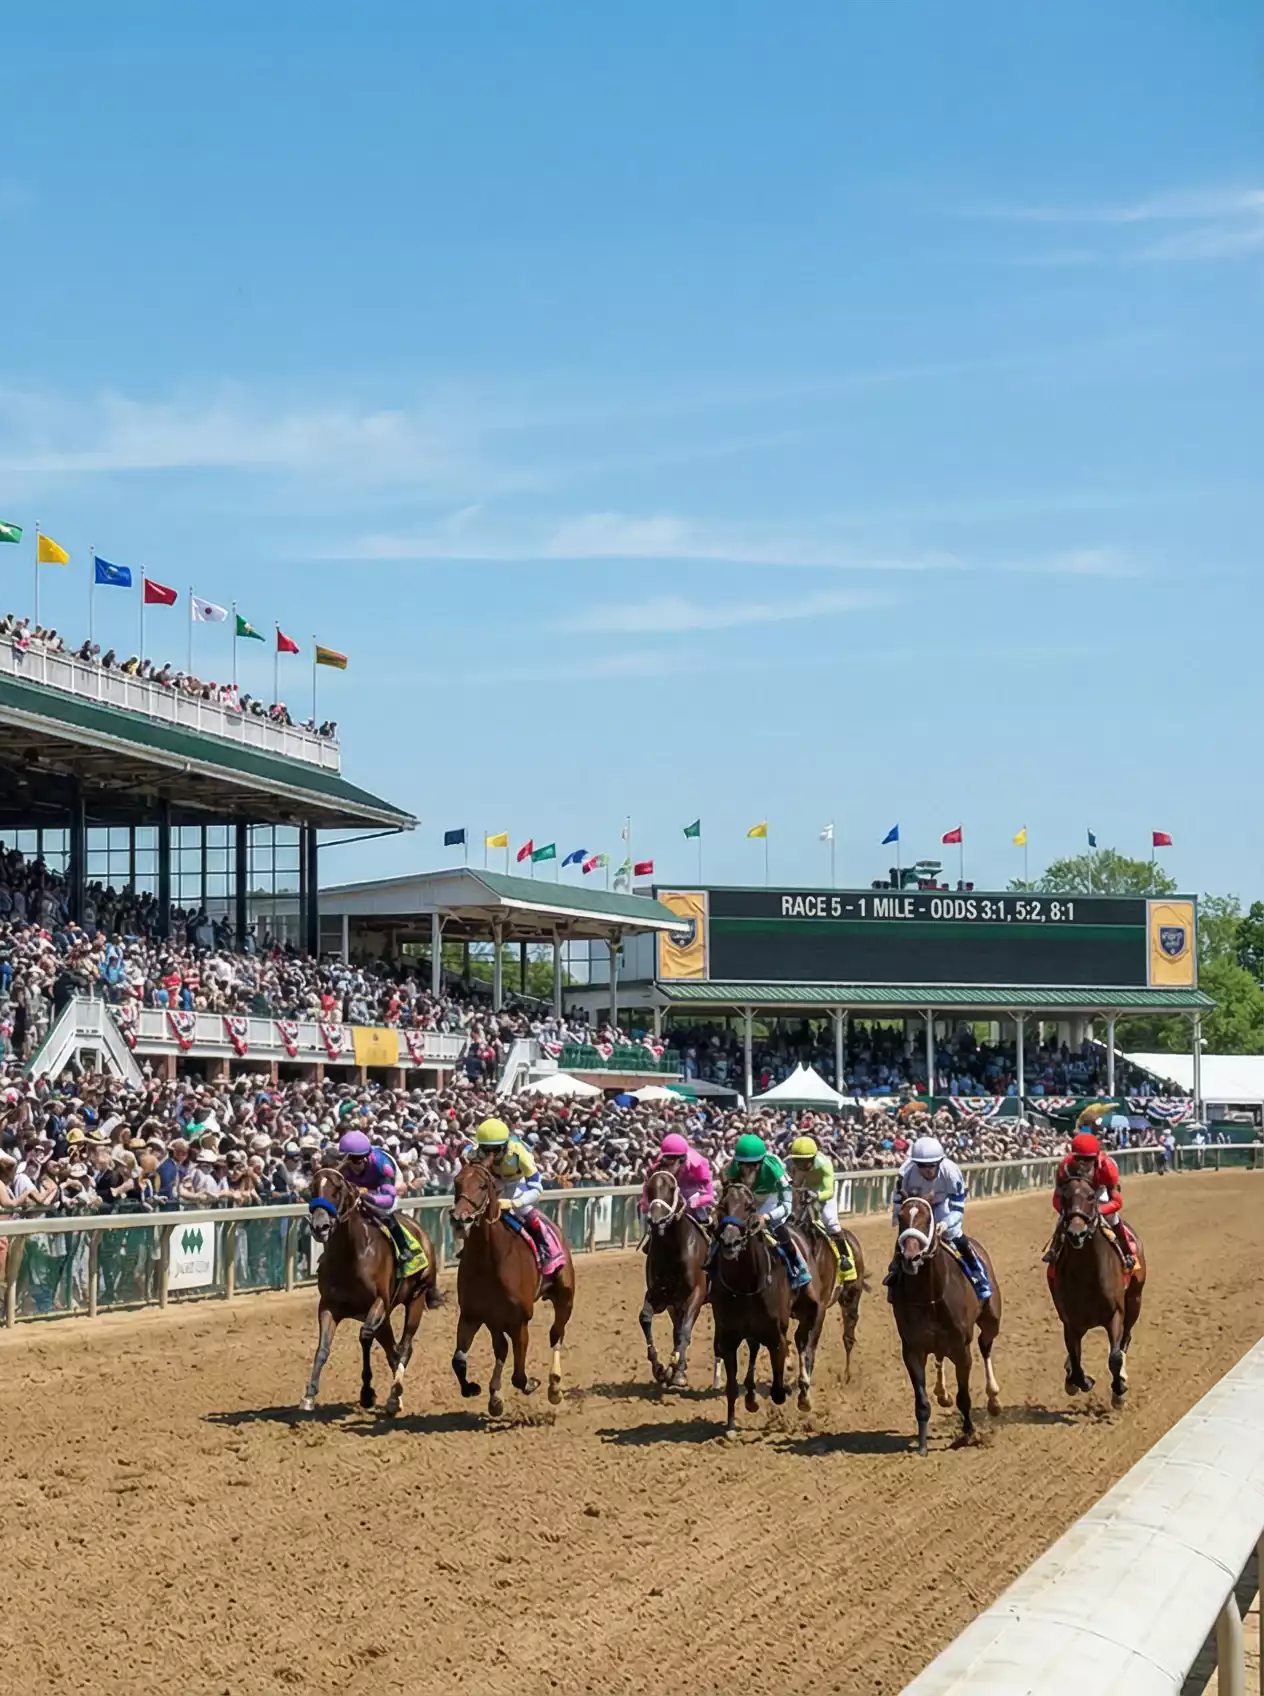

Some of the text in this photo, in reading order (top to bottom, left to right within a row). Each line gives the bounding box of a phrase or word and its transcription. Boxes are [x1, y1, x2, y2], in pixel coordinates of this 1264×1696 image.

[781, 895, 827, 916] RACE
[831, 897, 842, 917] 5
[857, 898, 866, 917] 1
[873, 897, 915, 918] MILE
[930, 899, 978, 919] ODDS
[981, 900, 1012, 922] 3:1,
[1015, 901, 1046, 923] 5:2,
[1050, 902, 1074, 921] 8:1
